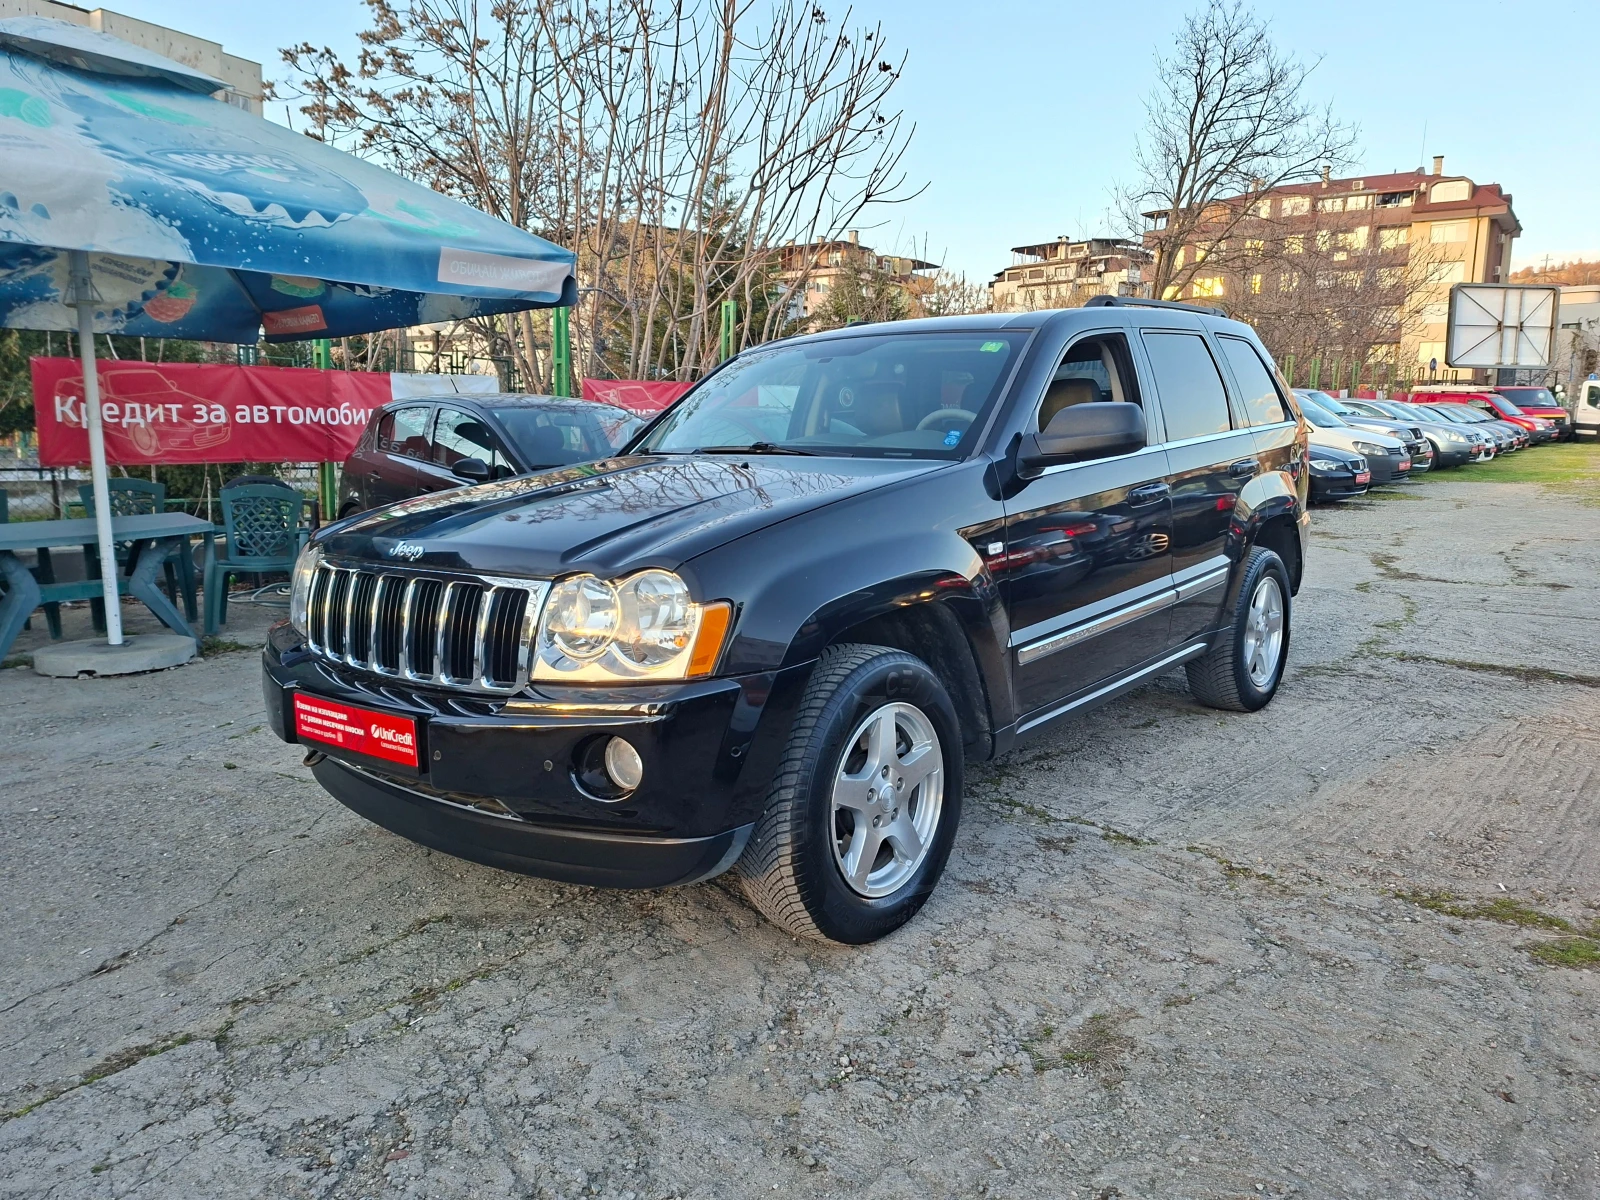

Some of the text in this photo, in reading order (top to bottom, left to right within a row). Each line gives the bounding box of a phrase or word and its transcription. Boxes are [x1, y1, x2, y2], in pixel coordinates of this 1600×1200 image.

[193, 403, 227, 424] за
[389, 540, 425, 561] Jeep
[379, 726, 414, 746] UniCredit
